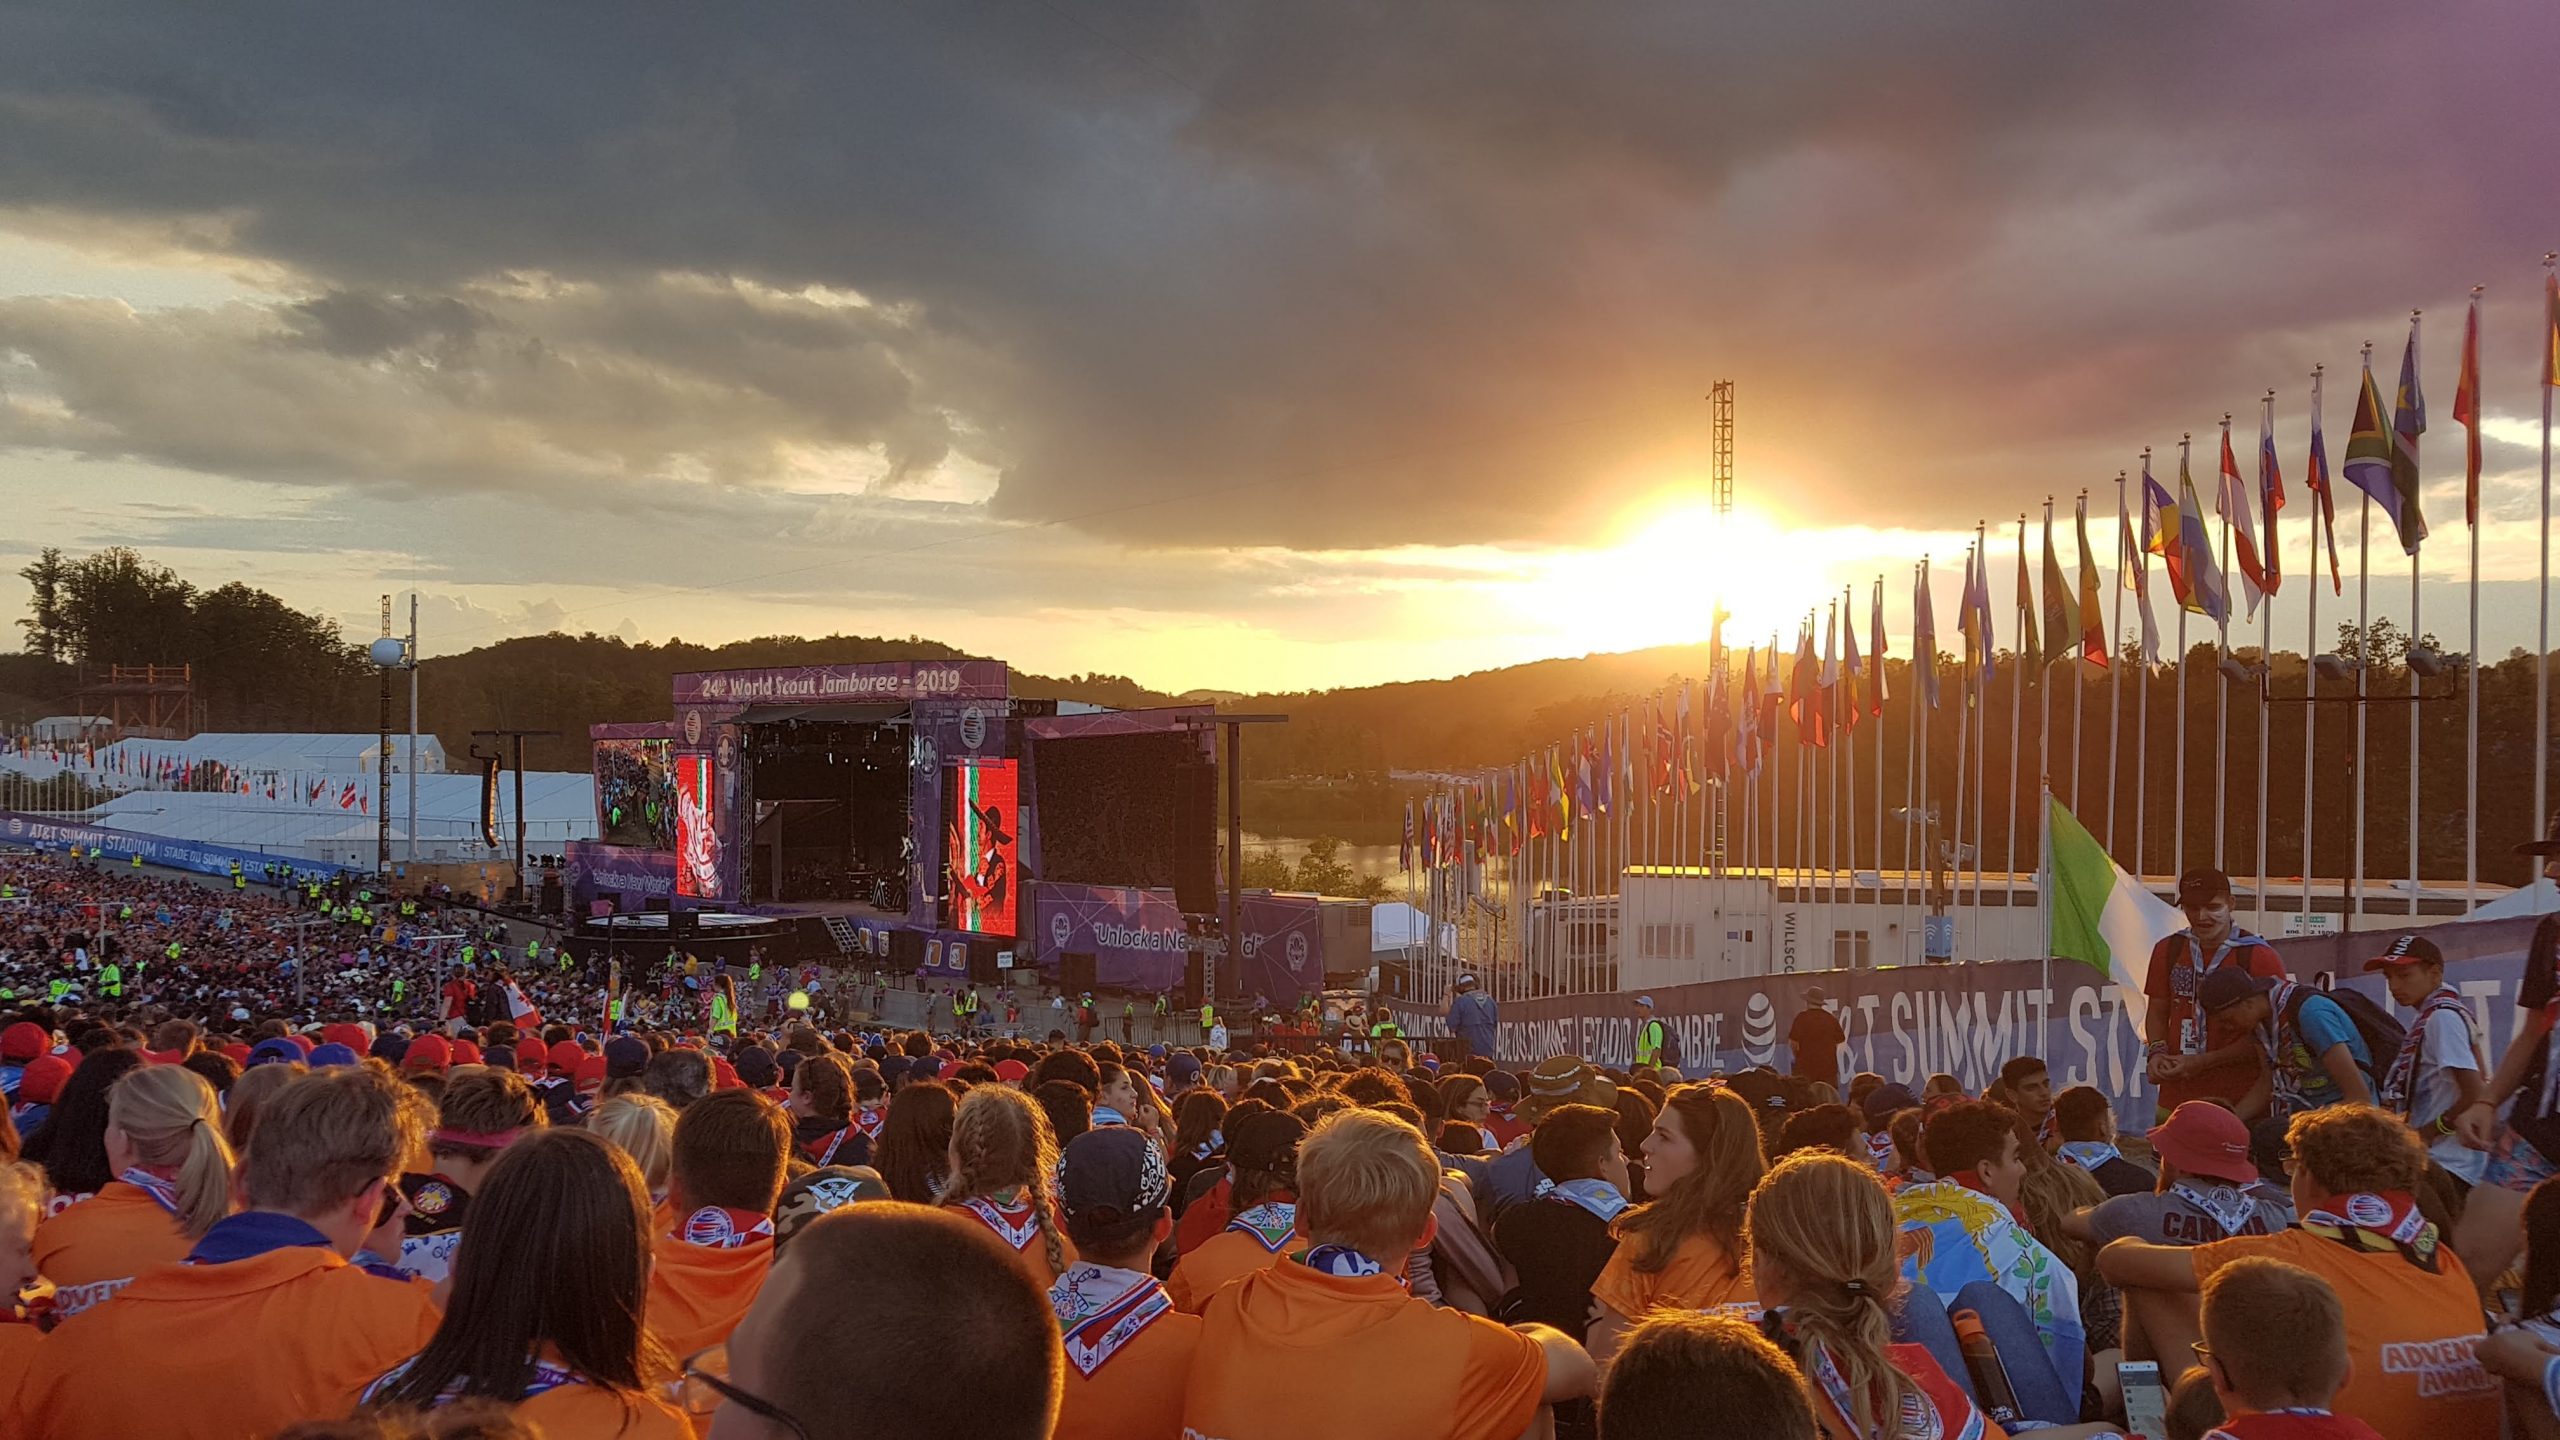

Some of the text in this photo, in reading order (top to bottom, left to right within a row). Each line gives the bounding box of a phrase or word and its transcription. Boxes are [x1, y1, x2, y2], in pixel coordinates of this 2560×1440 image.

[730, 675, 772, 696] World
[774, 675, 815, 695] Scout
[818, 673, 898, 694] Jamboree
[916, 669, 960, 692] 2019
[29, 824, 156, 857] AT&T SUMMIT STADIUM
[164, 846, 238, 869] STADE DU SOMME
[1151, 935, 1160, 949] a
[1583, 1016, 1631, 1066] ESTADIO
[1891, 988, 2053, 1091] SUMMIT
